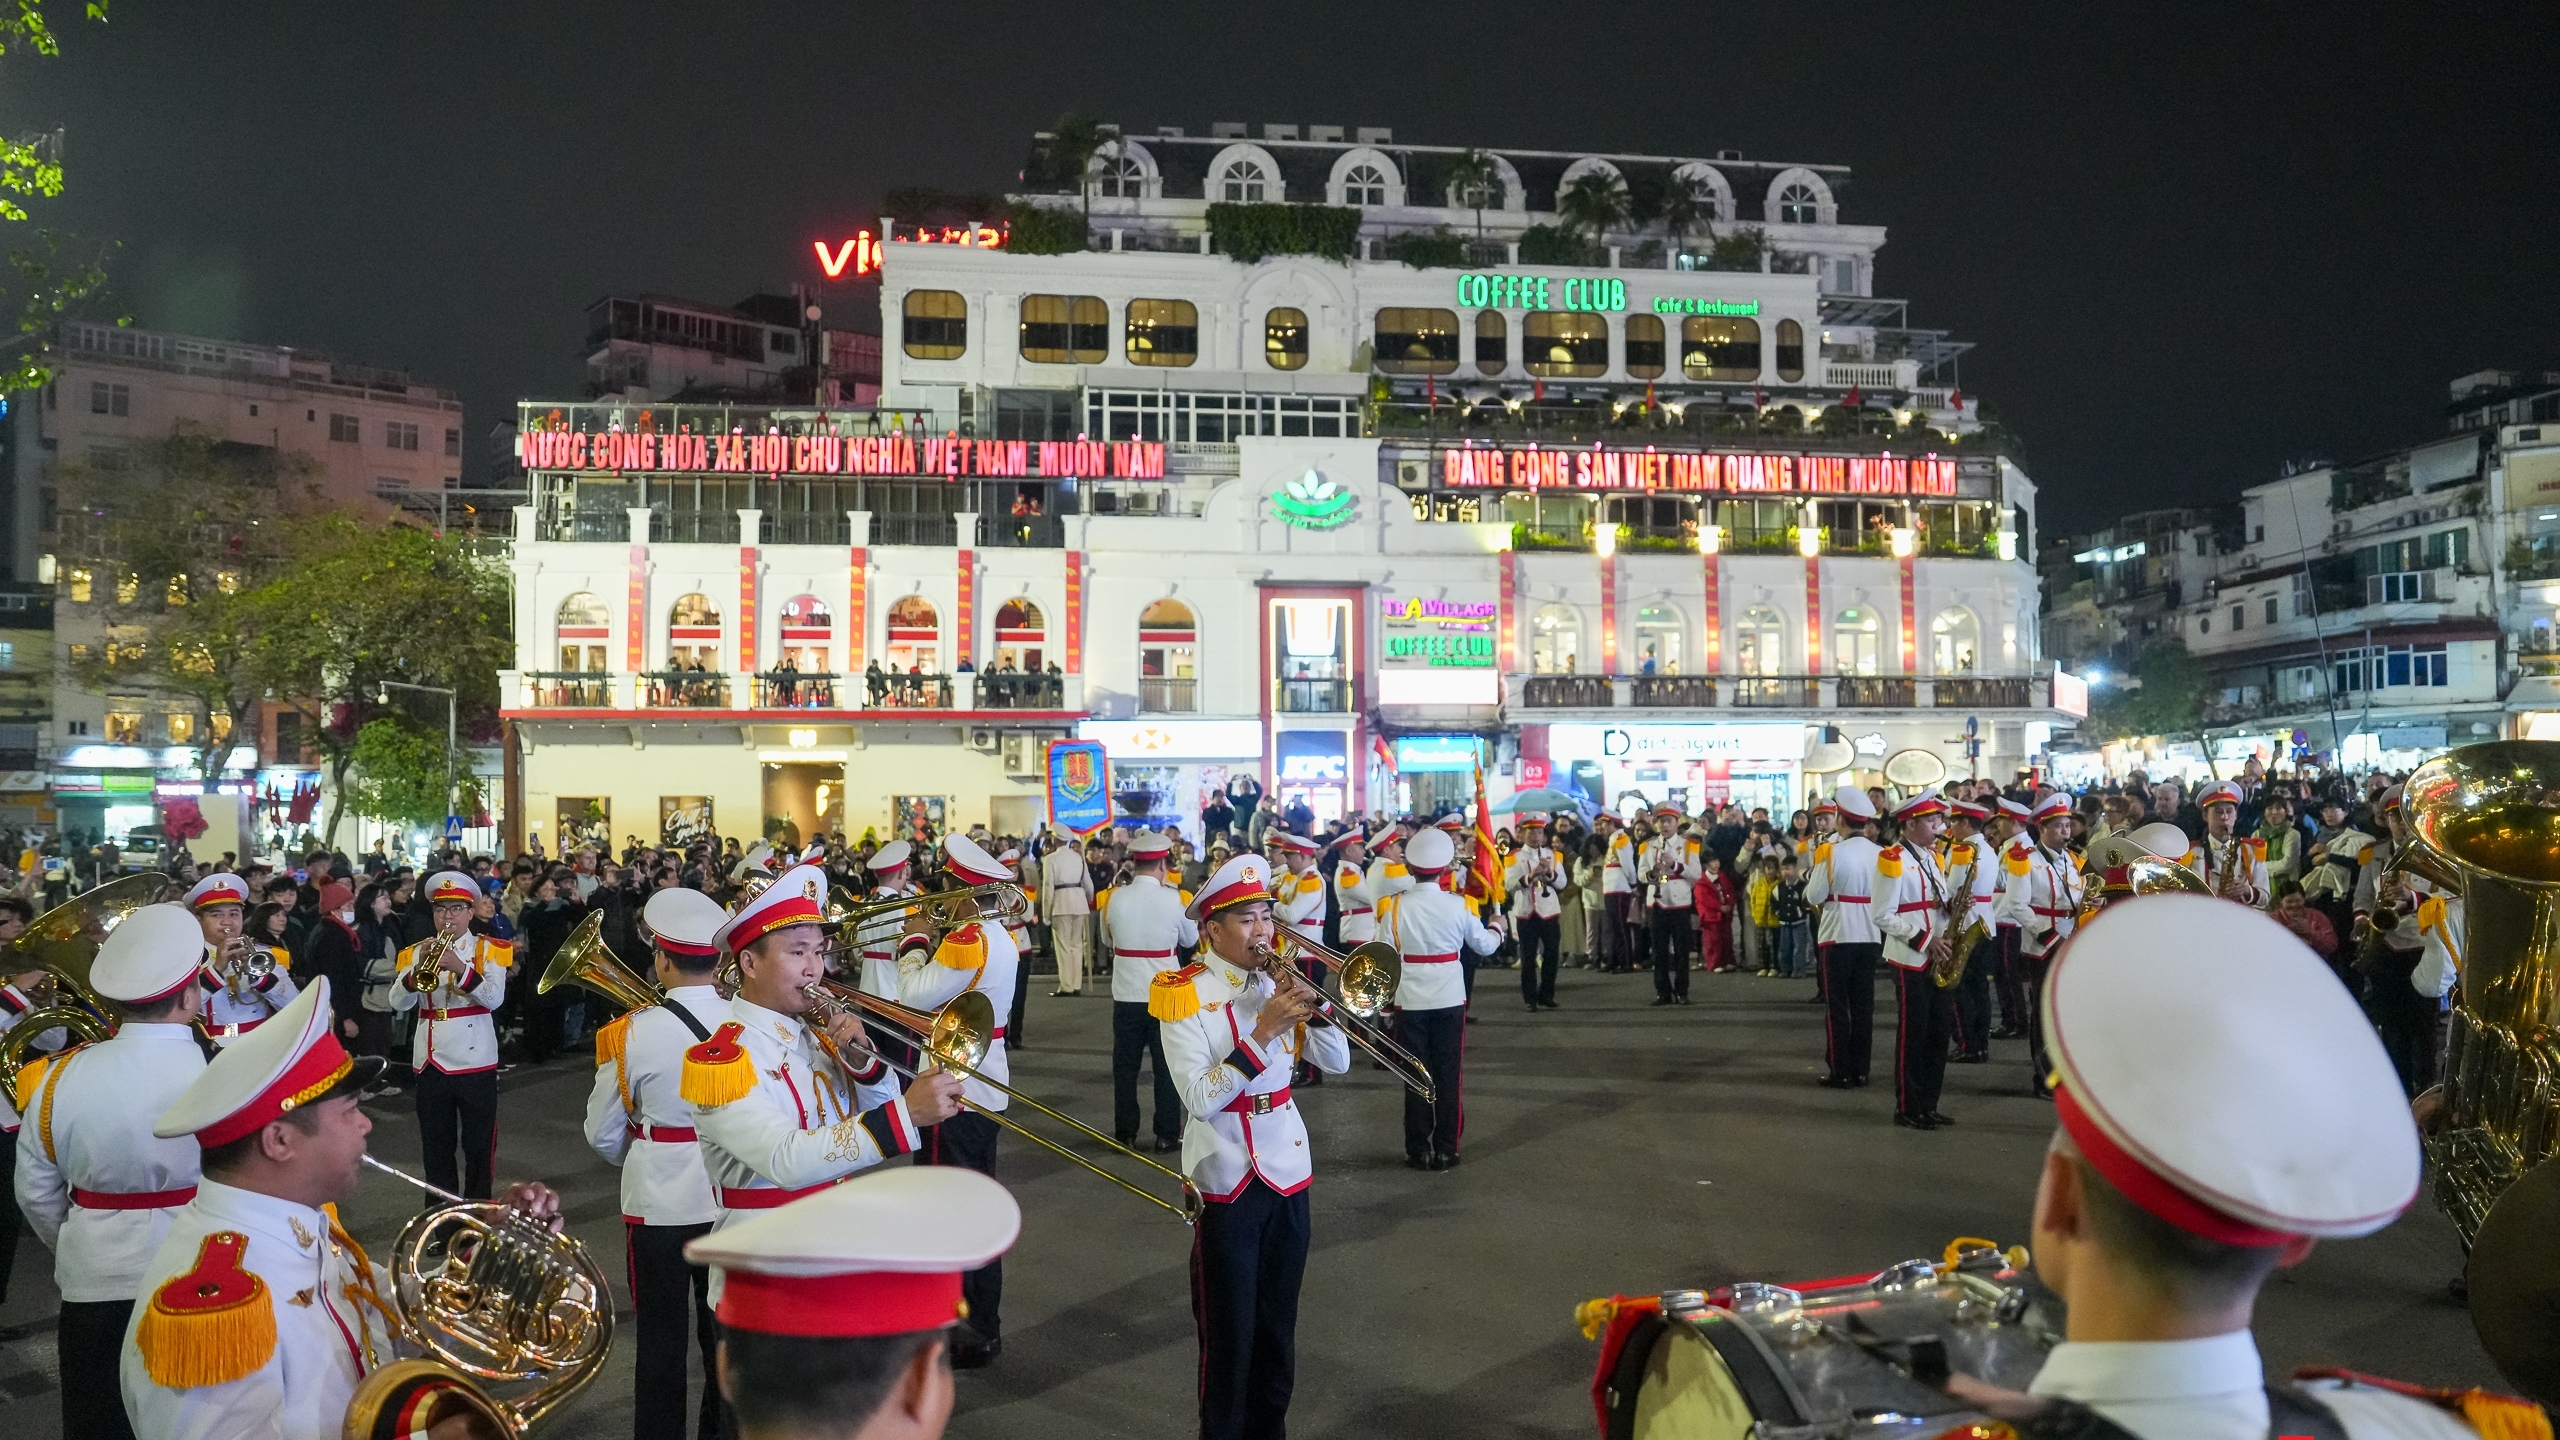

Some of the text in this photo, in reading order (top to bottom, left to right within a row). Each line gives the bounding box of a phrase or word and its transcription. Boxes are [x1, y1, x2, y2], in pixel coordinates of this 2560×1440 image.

[1457, 274, 1626, 312] COFFEE CLUB
[1653, 296, 1759, 315] Café & Restaurant
[521, 423, 1165, 482] NƯỚC CỘNG HÒA XÃ HỘI CHỦ NGHĨA VIỆT NAM MUÔN NĂM
[1445, 438, 1956, 496] ĐẢNG CỘNG SẢN VIỆT NAM QUANG VINH MUÔN NĂM
[1385, 636, 1493, 656] COFFEE CLUB
[1282, 756, 1345, 779] KFC
[1525, 765, 1543, 779] 03
